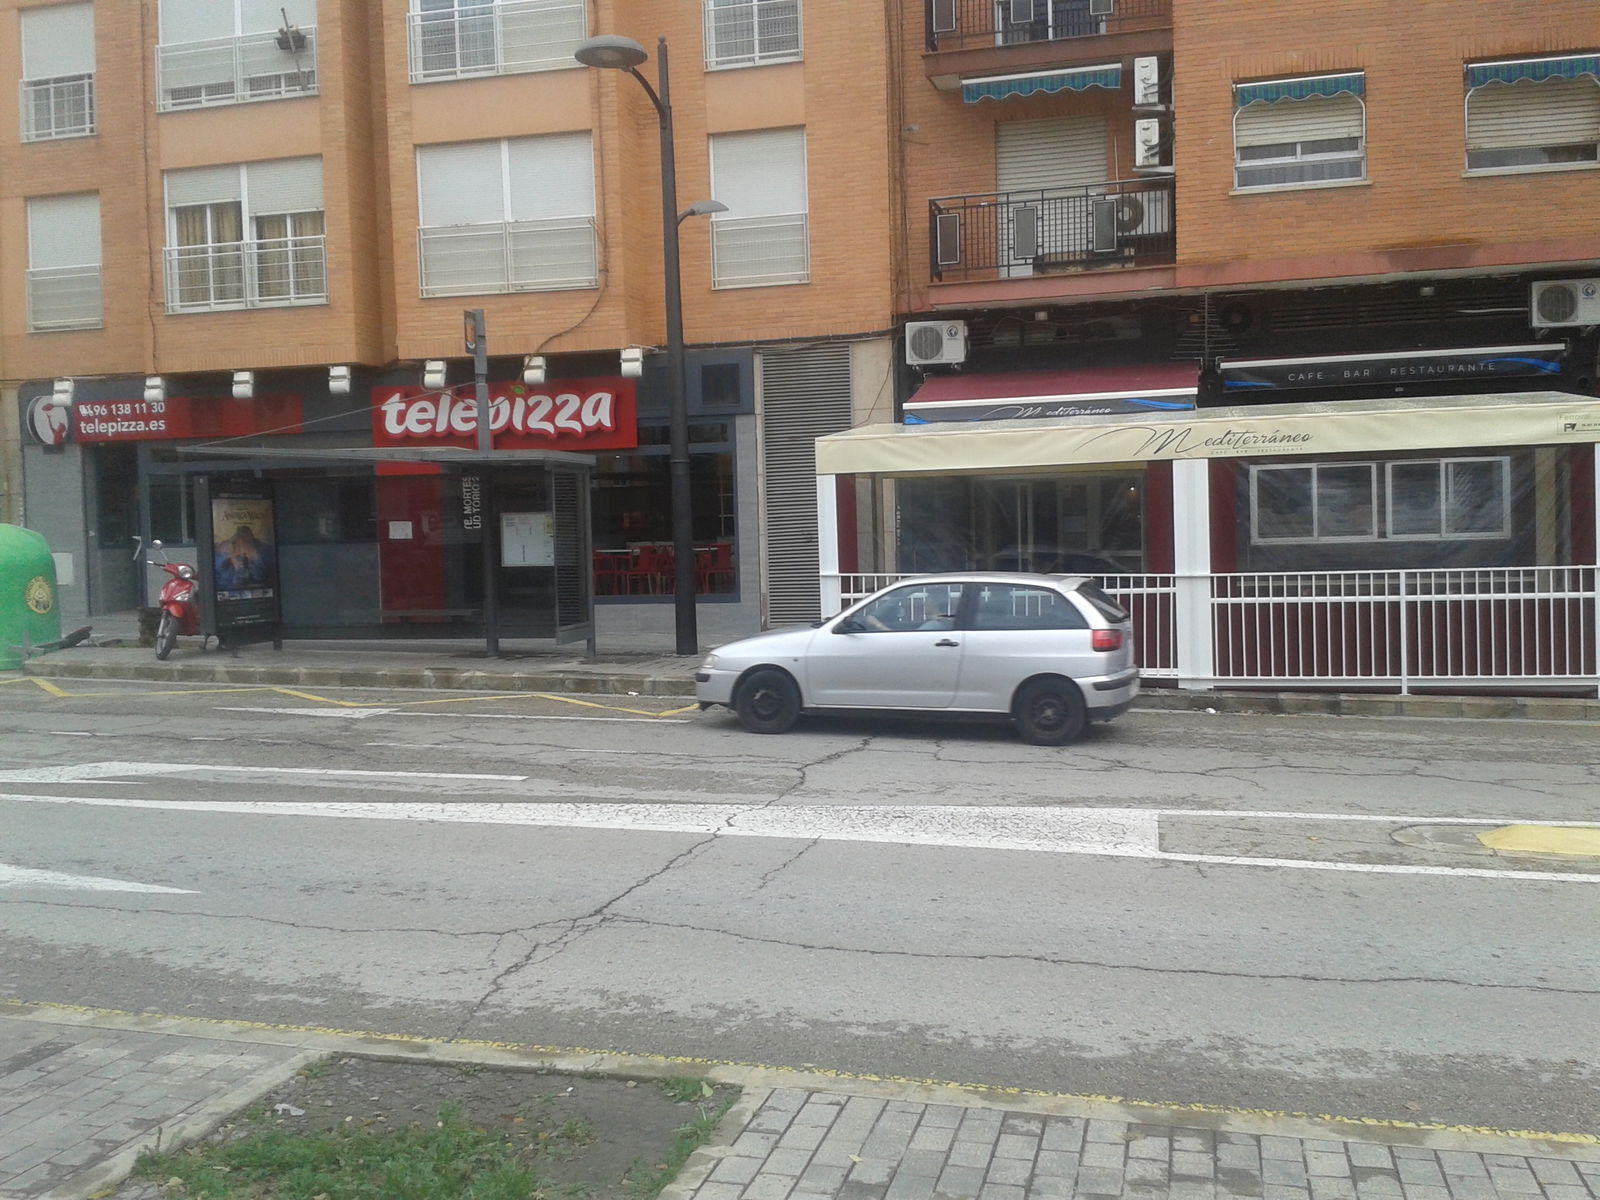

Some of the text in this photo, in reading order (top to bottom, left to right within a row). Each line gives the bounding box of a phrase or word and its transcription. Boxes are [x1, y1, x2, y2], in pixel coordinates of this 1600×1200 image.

[1288, 362, 1496, 381] CAFE BAR RESTAURANTE
[93, 402, 165, 416] 96 138 11 30
[80, 418, 166, 436] telepizza.es
[1073, 427, 1313, 456] Mediterráneo
